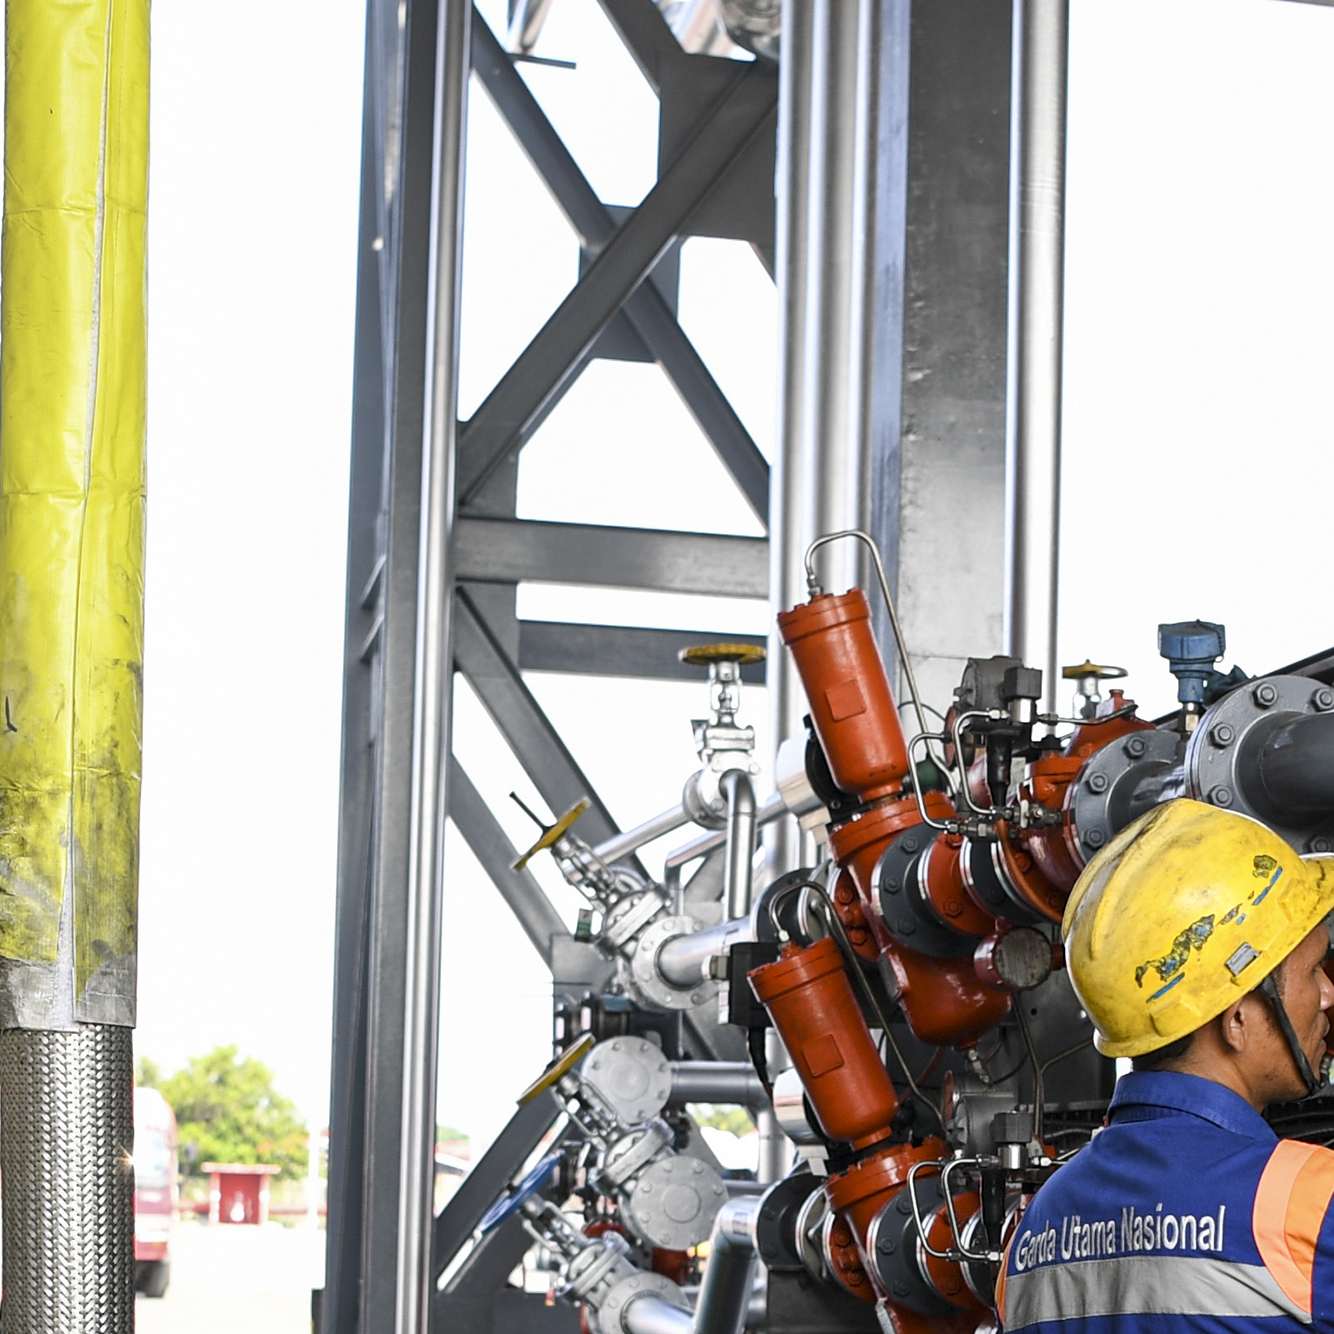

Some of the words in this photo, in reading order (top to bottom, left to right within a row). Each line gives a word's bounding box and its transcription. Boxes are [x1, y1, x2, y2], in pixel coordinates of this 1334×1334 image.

[1015, 1220, 1056, 1272] Garda
[1060, 1214, 1116, 1260] Utama
[1120, 1203, 1226, 1253] Nasional
